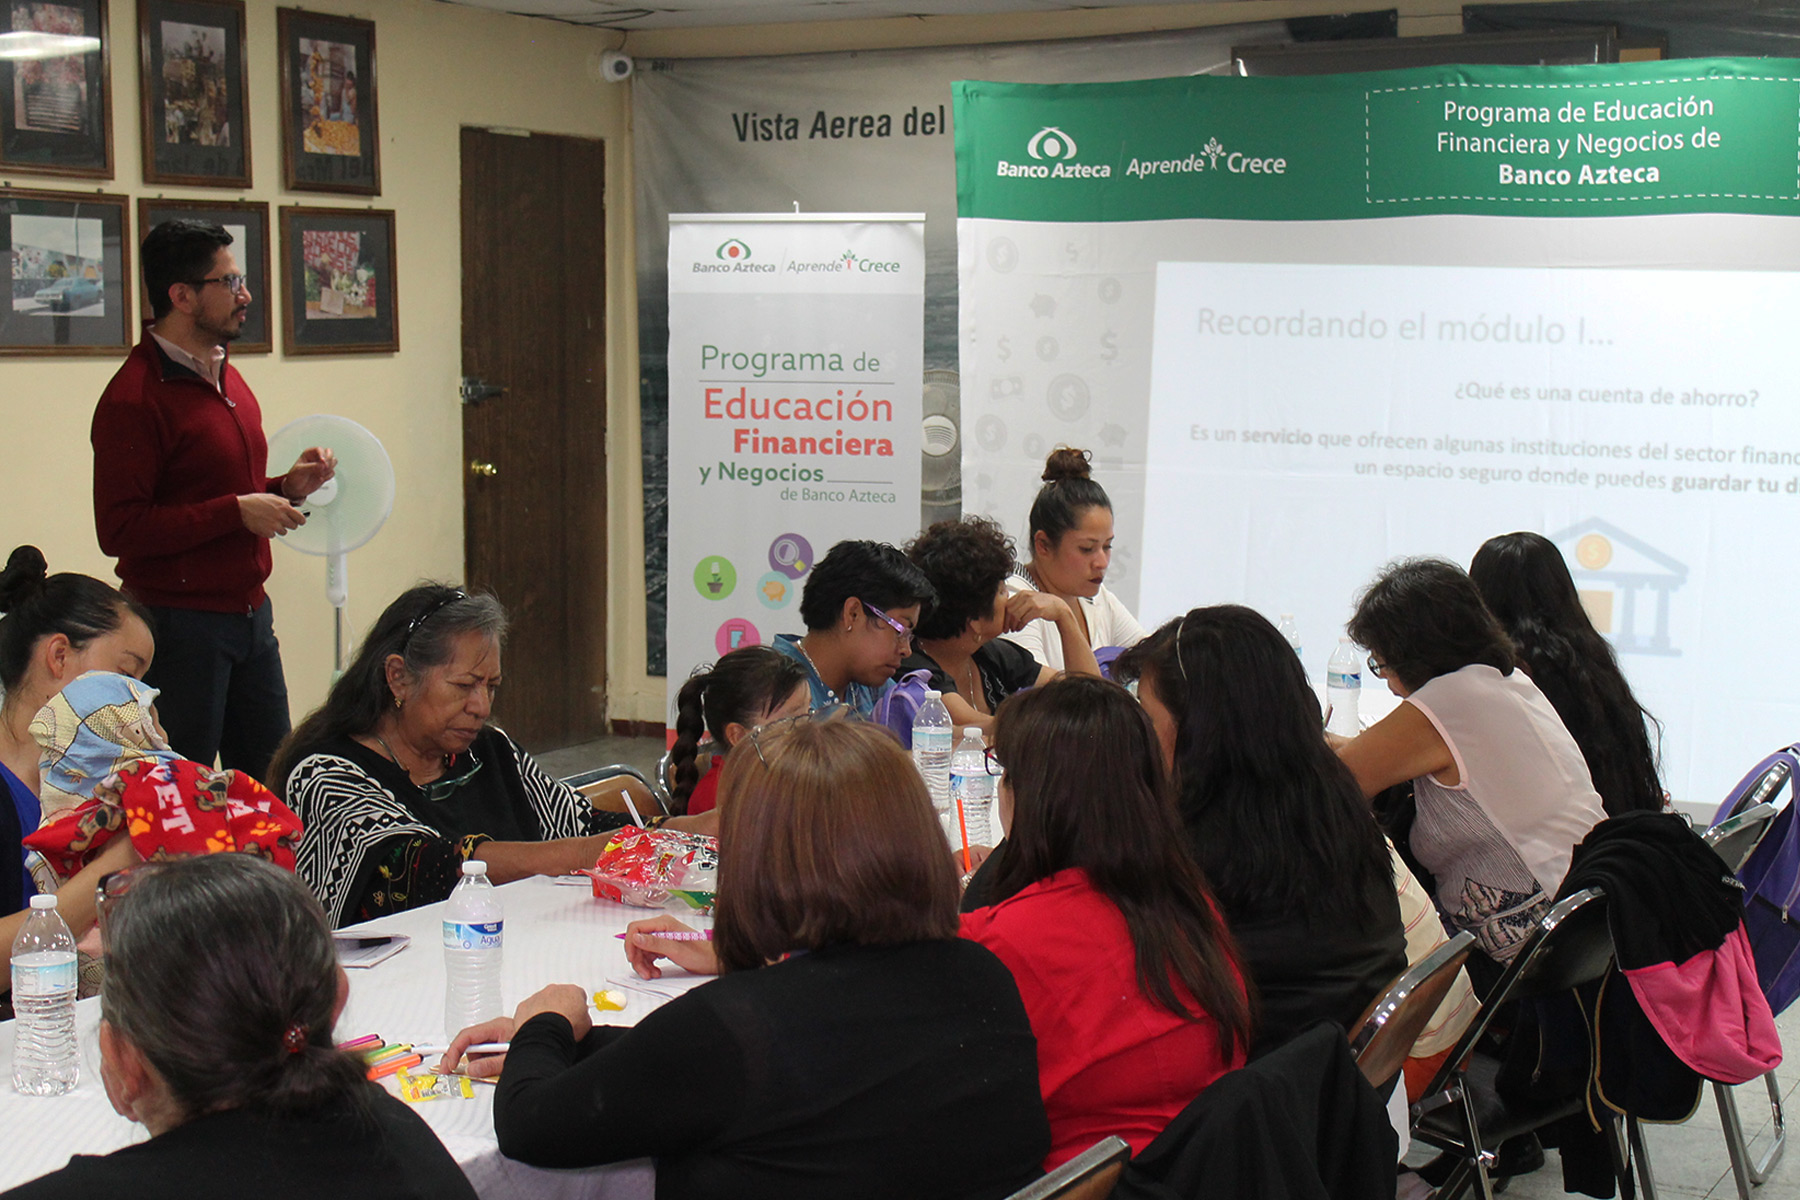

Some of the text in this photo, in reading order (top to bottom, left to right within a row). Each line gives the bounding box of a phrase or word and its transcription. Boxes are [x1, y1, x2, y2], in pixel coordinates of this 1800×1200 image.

[732, 105, 944, 141] Vista Aerea del
[1445, 95, 1713, 127] Programa de Educación
[1438, 127, 1720, 159] Financiera y Negocios de
[997, 161, 1110, 178] Banco Azteca
[1126, 153, 1286, 179] Aprende Crece
[1500, 164, 1659, 185] Banco Azteca
[693, 263, 775, 272] Banco Azteca
[787, 259, 900, 275] Aprende Crece
[1198, 307, 1388, 341] Recordando
[1399, 311, 1426, 342] el
[1439, 314, 1565, 345] módulo
[702, 345, 879, 377] Programa de
[705, 387, 892, 421] Educación
[1455, 382, 1759, 407] ¿Qué es una cuenta de ahorro?
[734, 428, 893, 456] Financiera
[1190, 424, 1209, 441] Es
[1214, 428, 1237, 441] un
[1242, 428, 1312, 445] servicio
[1317, 433, 1352, 450] que
[1357, 431, 1427, 449] ofrecen
[1433, 434, 1504, 456] algunas
[1511, 437, 1632, 458] instituciones
[1639, 442, 1668, 460] del
[1674, 443, 1735, 462] sector
[699, 462, 823, 486] y Negocios
[1354, 462, 1377, 475] un
[1382, 461, 1454, 481] espacio
[1459, 467, 1522, 484] seguro
[1528, 466, 1589, 485] donde
[1595, 470, 1666, 489] puedes
[1672, 471, 1751, 493] guardar
[1758, 478, 1778, 493] tu
[780, 487, 895, 503] de Banco Azteca
